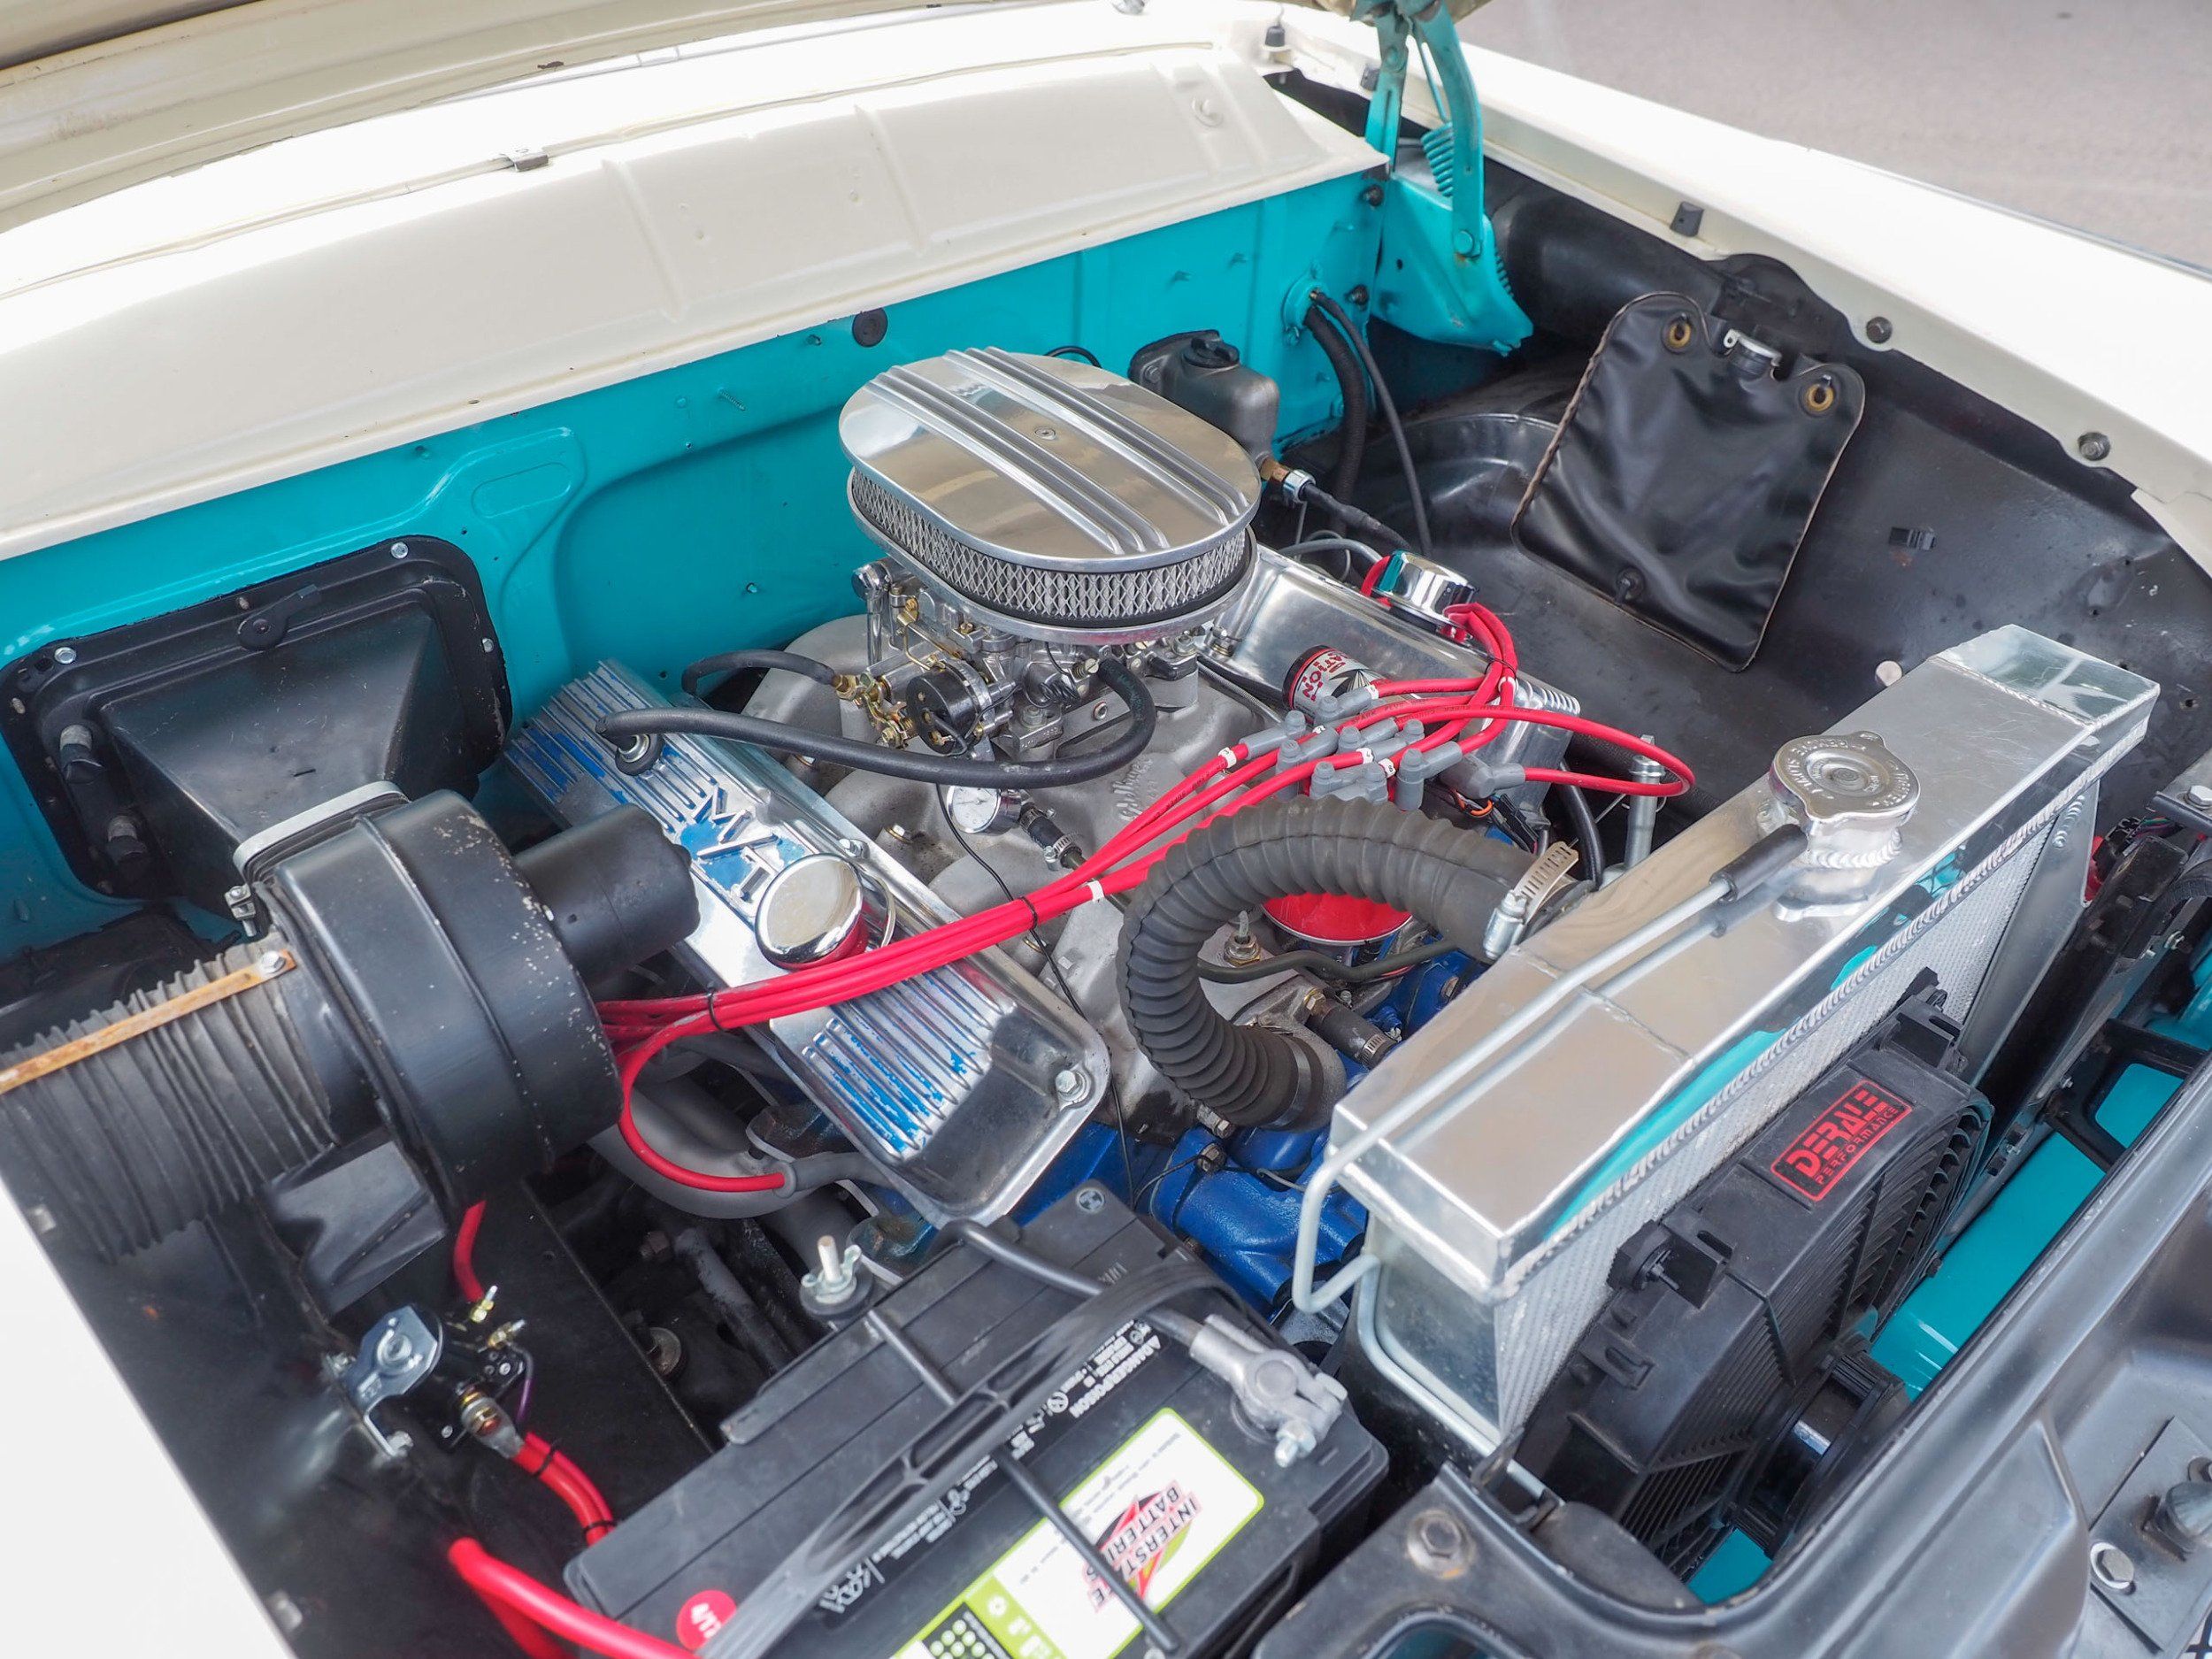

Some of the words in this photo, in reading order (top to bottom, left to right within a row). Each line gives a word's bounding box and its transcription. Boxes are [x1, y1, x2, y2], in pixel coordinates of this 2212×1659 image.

[1786, 1089, 1889, 1179] DERALE
[1815, 1105, 1899, 1186] PERFORMANCE
[1086, 1486, 1179, 1577] BATTERIS
[1094, 1496, 1198, 1604] INTERSTE
